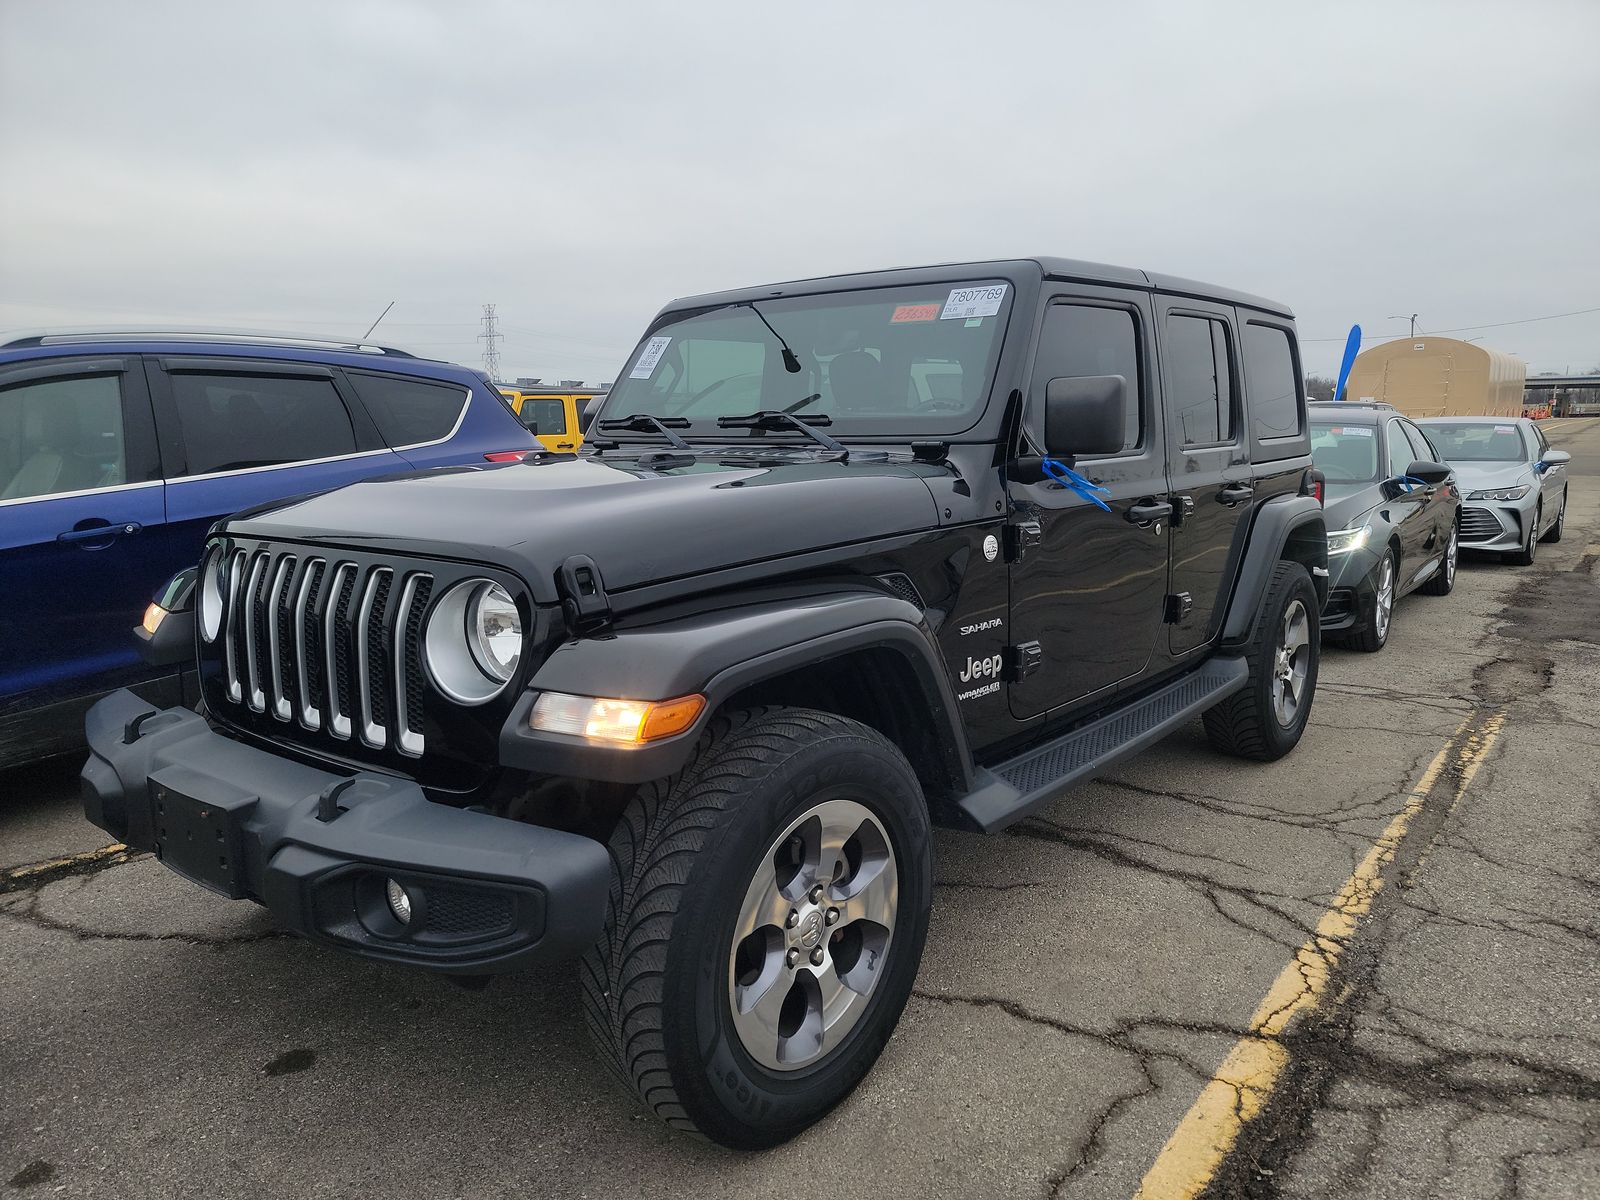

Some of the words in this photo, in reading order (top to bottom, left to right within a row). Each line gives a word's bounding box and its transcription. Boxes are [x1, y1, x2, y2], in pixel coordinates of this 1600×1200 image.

[952, 288, 1003, 303] 7807769
[960, 618, 1003, 636] SAHARA
[960, 654, 1003, 683] Jeep
[958, 682, 1000, 701] WRANGLER
